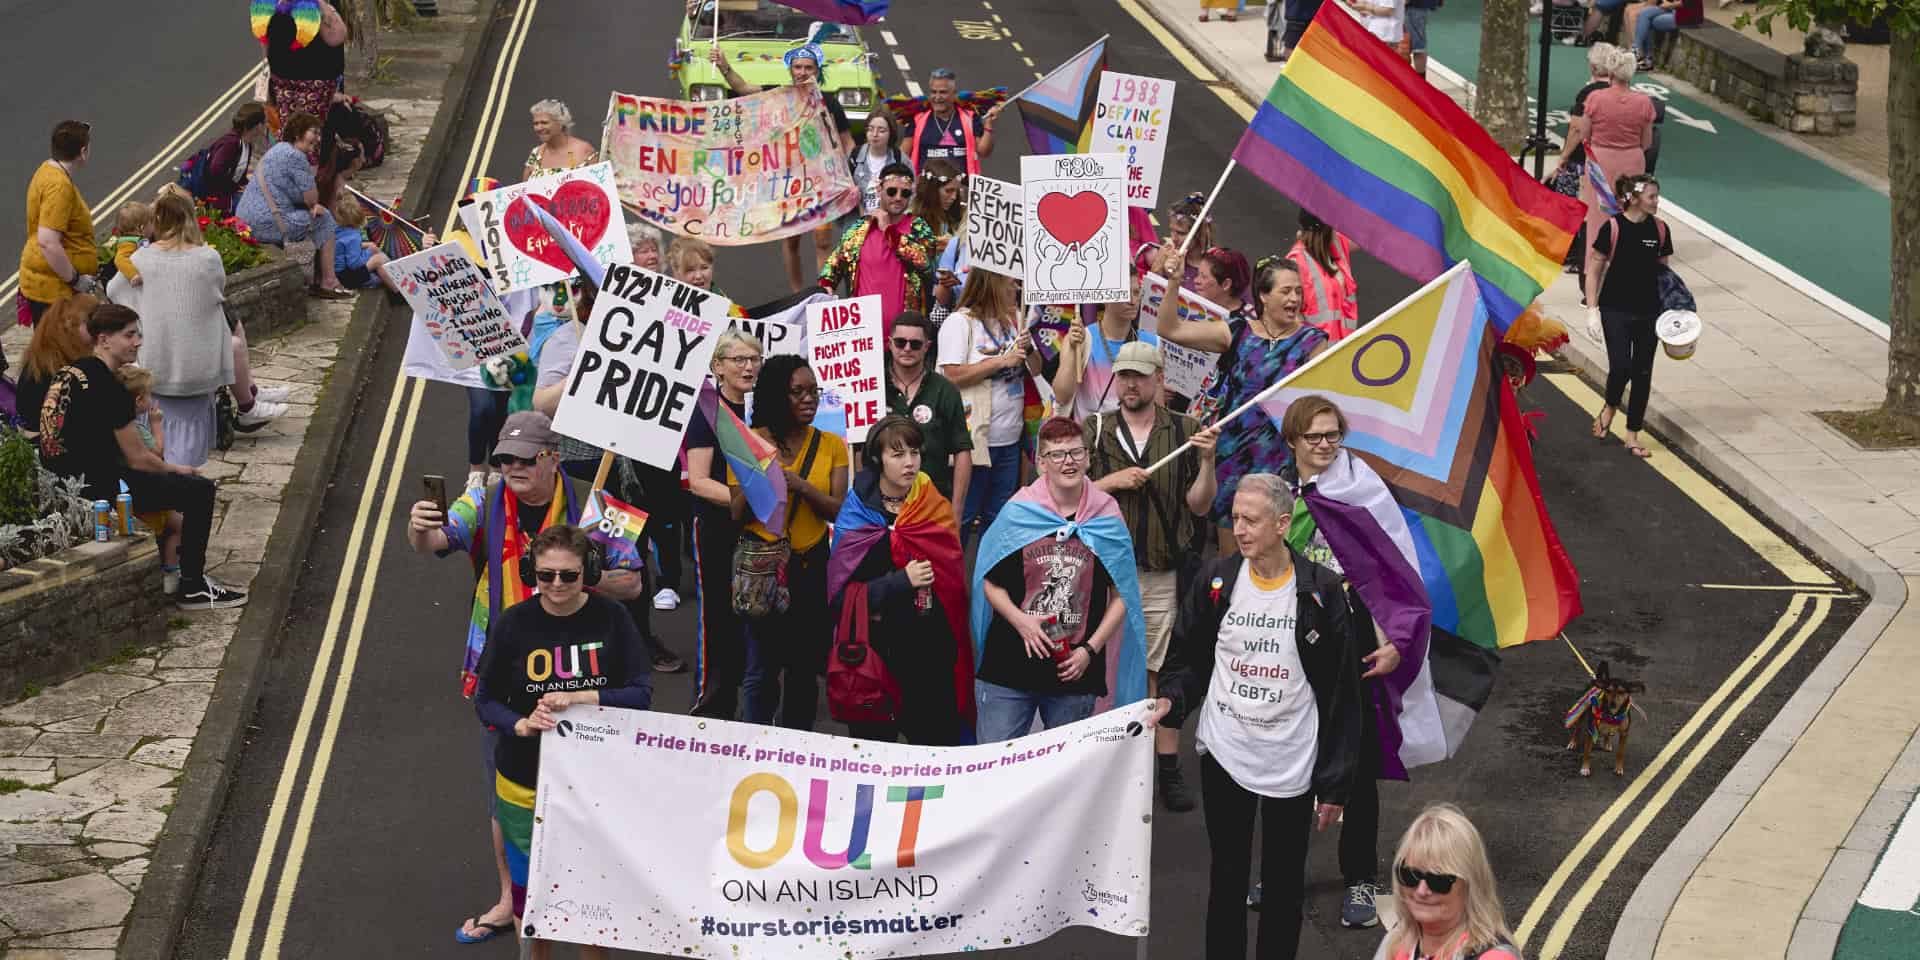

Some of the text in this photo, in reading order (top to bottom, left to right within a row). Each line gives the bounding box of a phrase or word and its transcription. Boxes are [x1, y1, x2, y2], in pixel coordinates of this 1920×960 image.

[1111, 78, 1160, 106] 1988
[617, 95, 708, 136] PRIDE
[1097, 102, 1162, 126] DEFYING
[1106, 124, 1157, 141] CLAUSE
[972, 177, 1003, 197] 1972
[1128, 185, 1152, 200] USE
[510, 197, 601, 231] MAIAGE
[970, 191, 1024, 226] REME
[480, 201, 511, 291] 2013
[527, 222, 584, 254] Equaty
[969, 235, 1007, 266] WAS
[601, 263, 649, 305] 1972
[672, 285, 710, 316] UK
[664, 309, 712, 336] PRIDE
[820, 302, 861, 332] AIDS
[599, 306, 704, 371] GAY
[814, 337, 873, 361] FIGHT THE
[817, 358, 861, 381] VIRUS
[568, 350, 695, 432] PRIDE
[851, 377, 878, 393] THE
[844, 400, 878, 428] PLE
[1226, 611, 1297, 630] Solidarit
[1244, 638, 1280, 654] with
[526, 641, 603, 682] OUT
[1230, 658, 1289, 680] Uganda
[526, 676, 608, 693] ON AN ISLAND
[1230, 681, 1283, 704] LGBTs!
[575, 722, 620, 736] StoneCrabs
[575, 732, 604, 743] Theatre
[635, 731, 1067, 778] Pride in self, pride in place, pride in our history
[726, 772, 945, 870] OUT
[722, 875, 938, 902] ON AN ISLAND
[701, 912, 964, 938] #ourstoriesmatter
